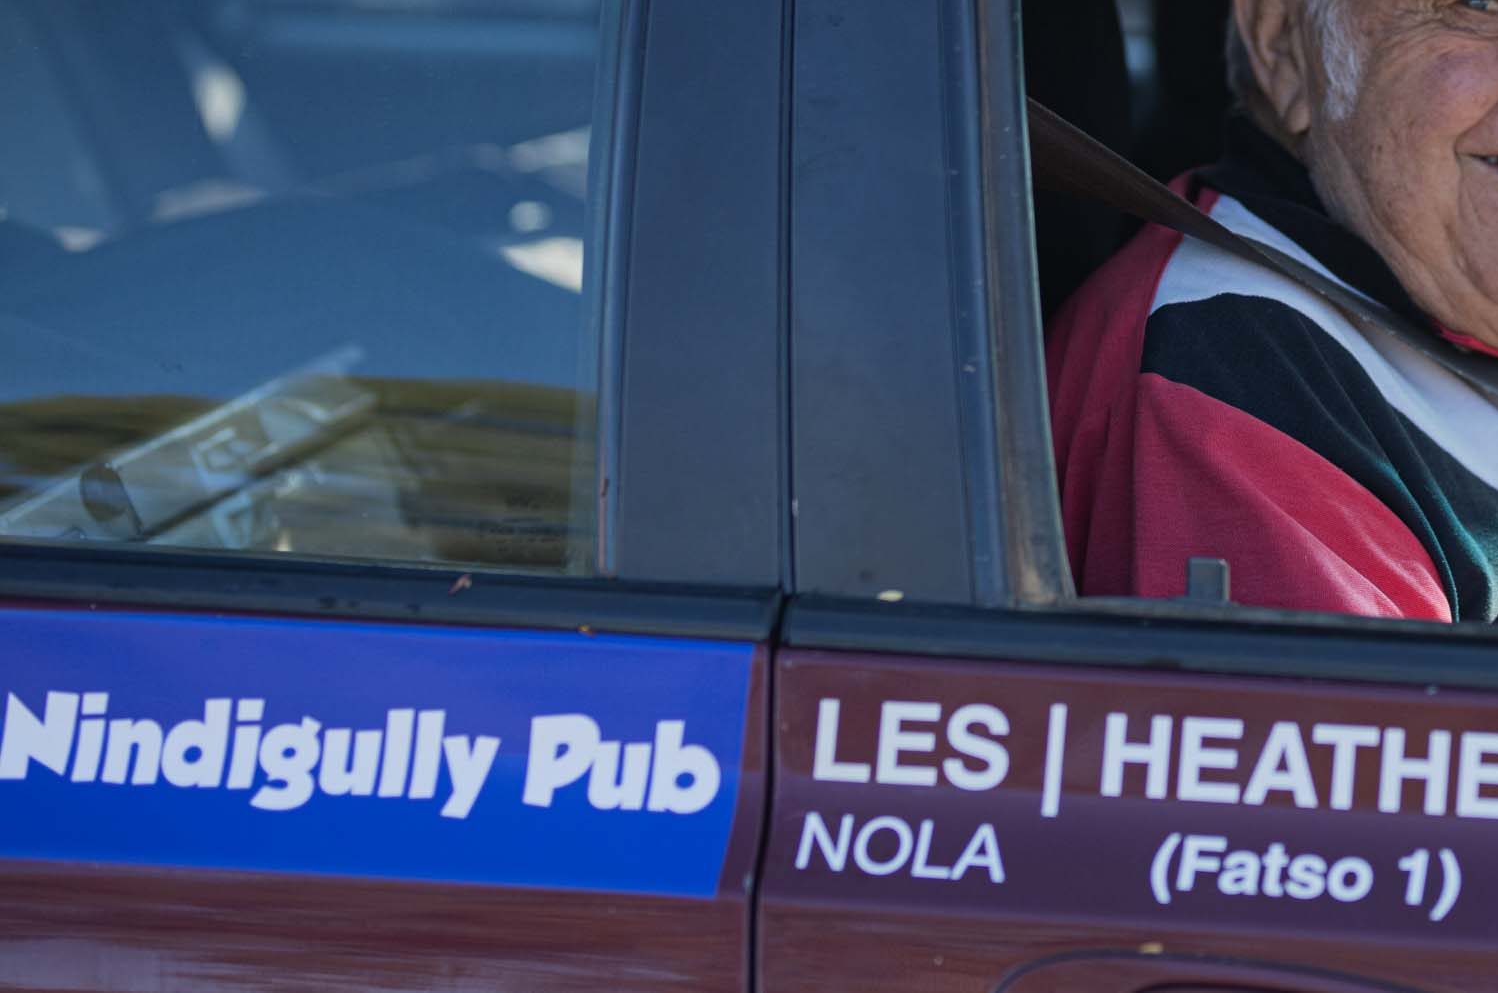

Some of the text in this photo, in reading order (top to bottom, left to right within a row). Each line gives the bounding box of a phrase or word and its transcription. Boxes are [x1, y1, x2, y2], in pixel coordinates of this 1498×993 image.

[0, 691, 721, 819] Nindigully Pub
[812, 697, 1011, 792] LES
[795, 811, 1007, 884] NOLA
[1148, 831, 1462, 923] (Fatso 1)
